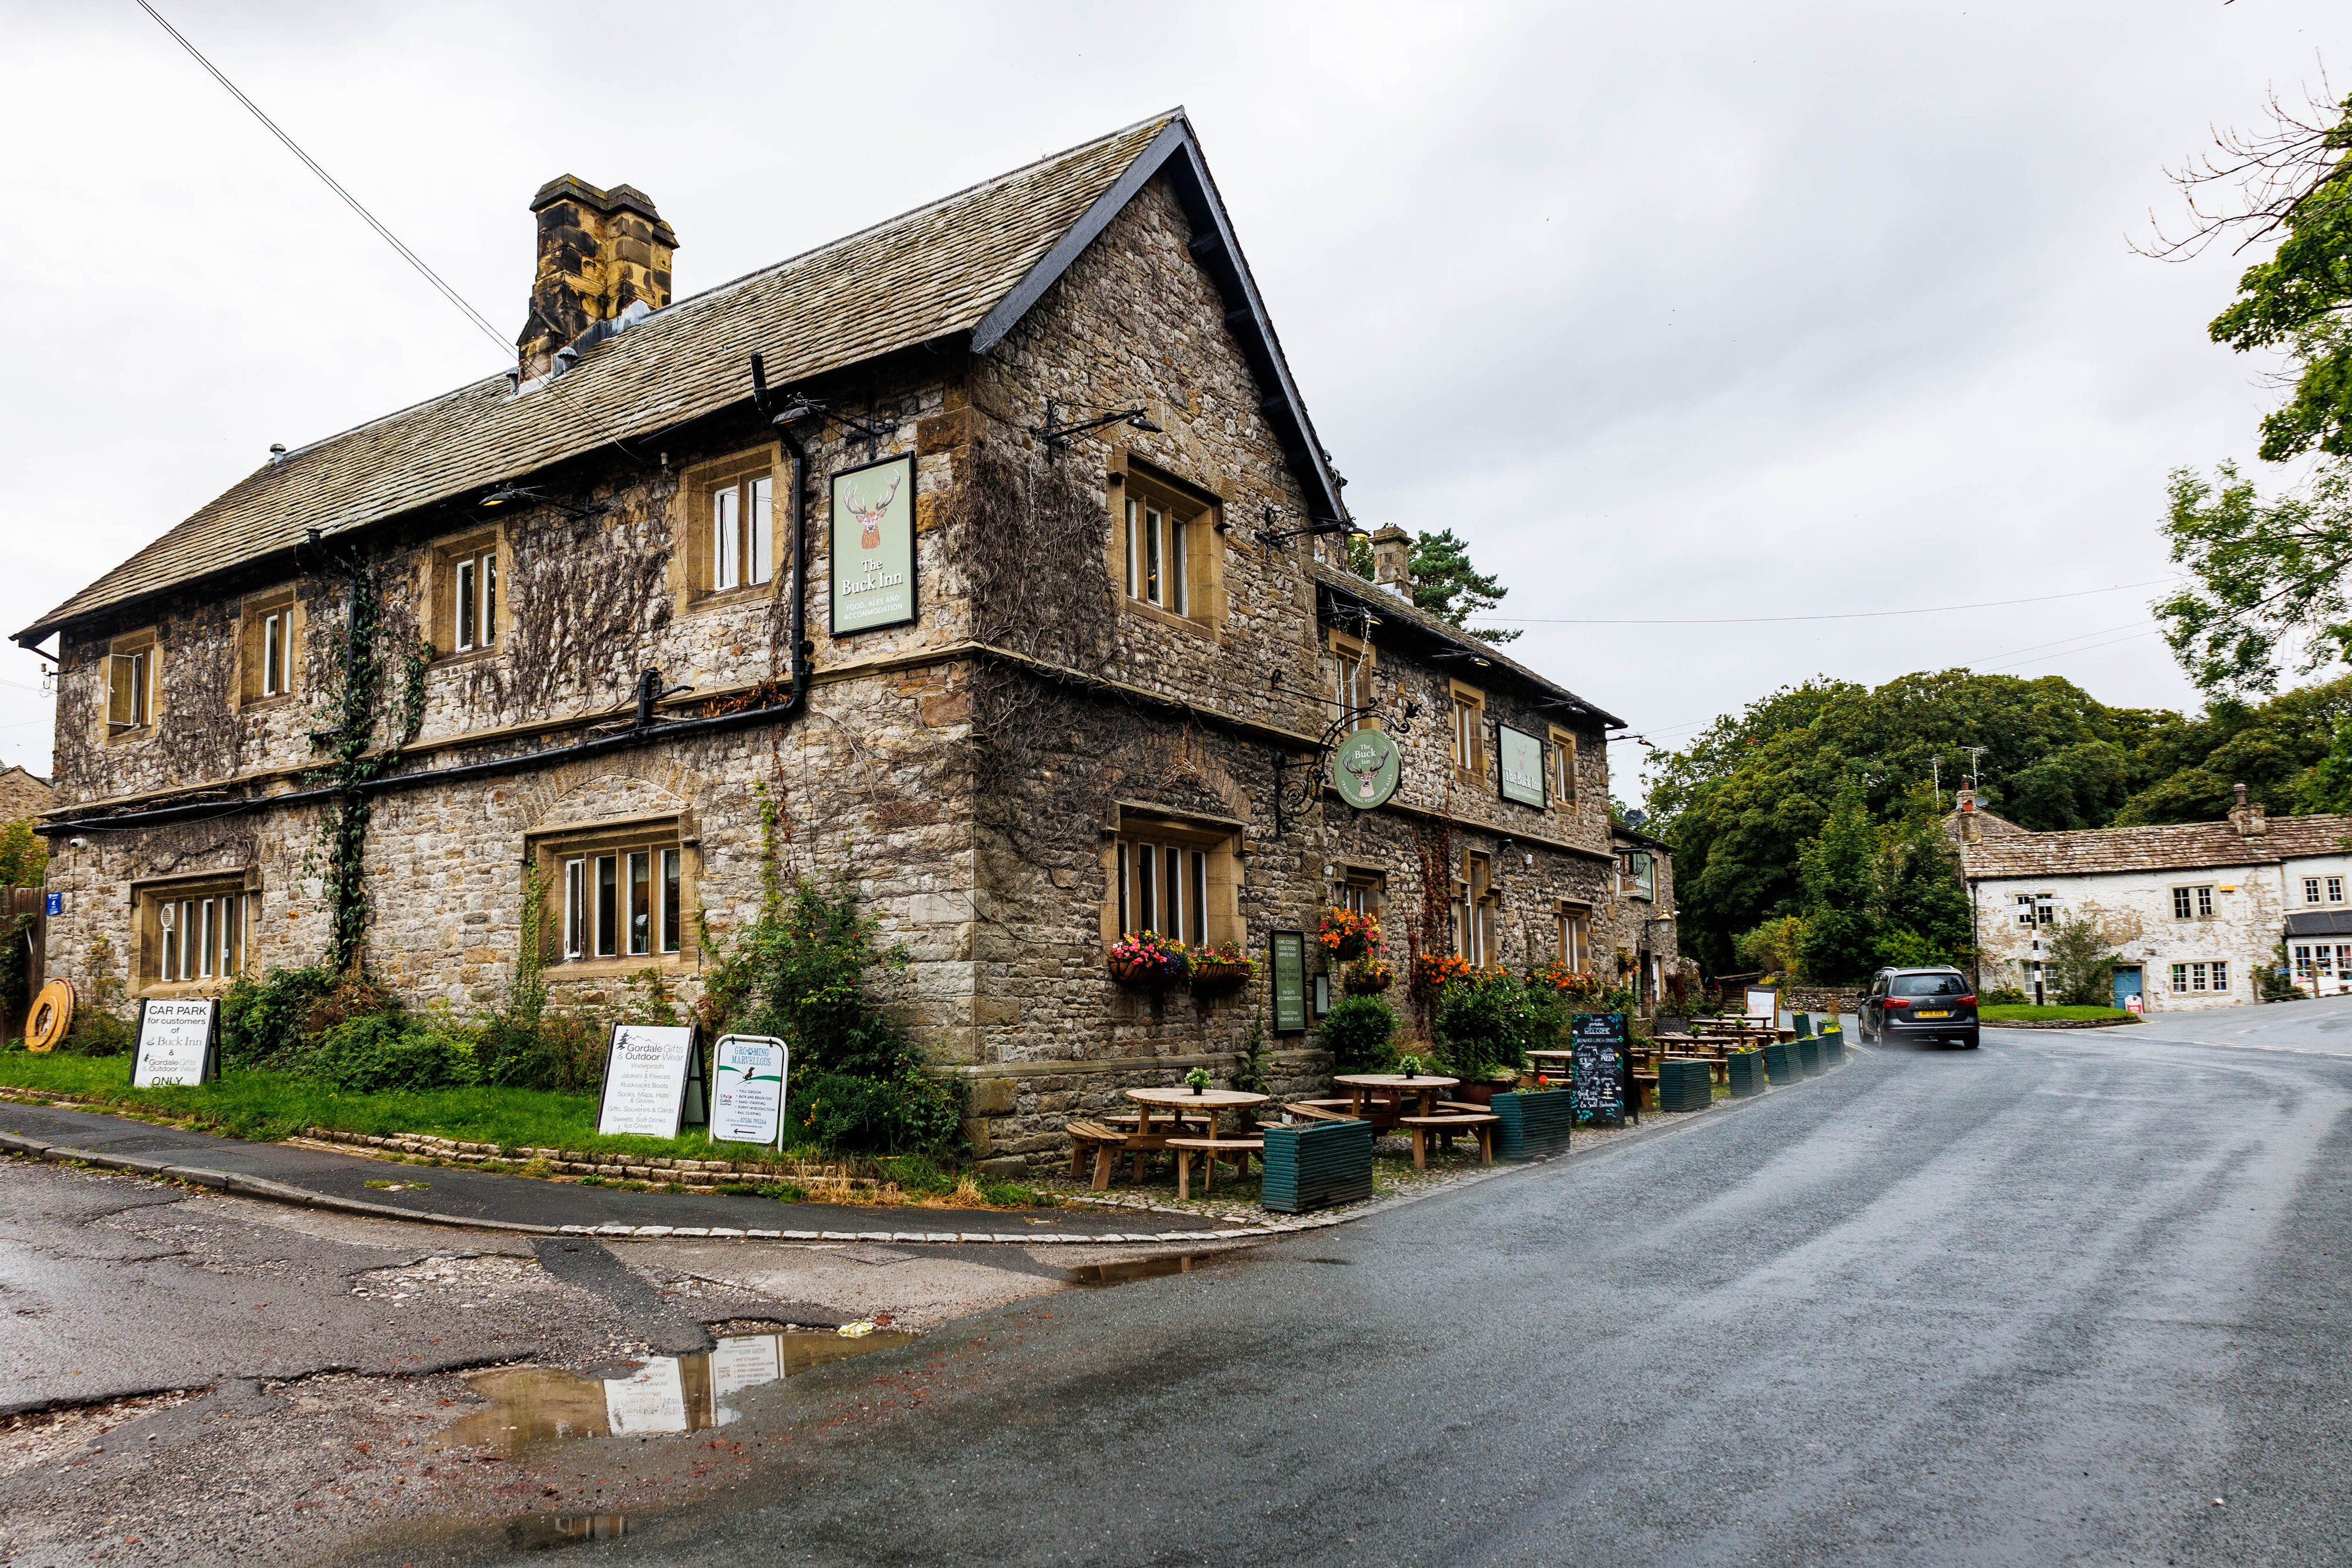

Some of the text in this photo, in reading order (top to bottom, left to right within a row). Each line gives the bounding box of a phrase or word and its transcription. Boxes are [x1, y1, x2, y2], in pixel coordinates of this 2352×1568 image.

[862, 559, 883, 573] The
[842, 571, 904, 596] Buck Inn
[846, 594, 900, 611] FOOD, ALES AND
[844, 603, 903, 621] ACCOMMODATION
[1354, 748, 1377, 758] Buck
[1504, 768, 1541, 792] The Buck Inn
[1341, 780, 1364, 803] TRADITIONAL
[1365, 787, 1387, 803] YORKSHIRE
[149, 1006, 207, 1015] CAR PARK
[158, 1037, 202, 1046] Buck Inn
[627, 1044, 684, 1053] Gordale Gifts
[617, 1052, 684, 1061] & Outdoor Wear
[731, 1055, 771, 1066] MARVELLOUS
[152, 1076, 183, 1085] ONLY
